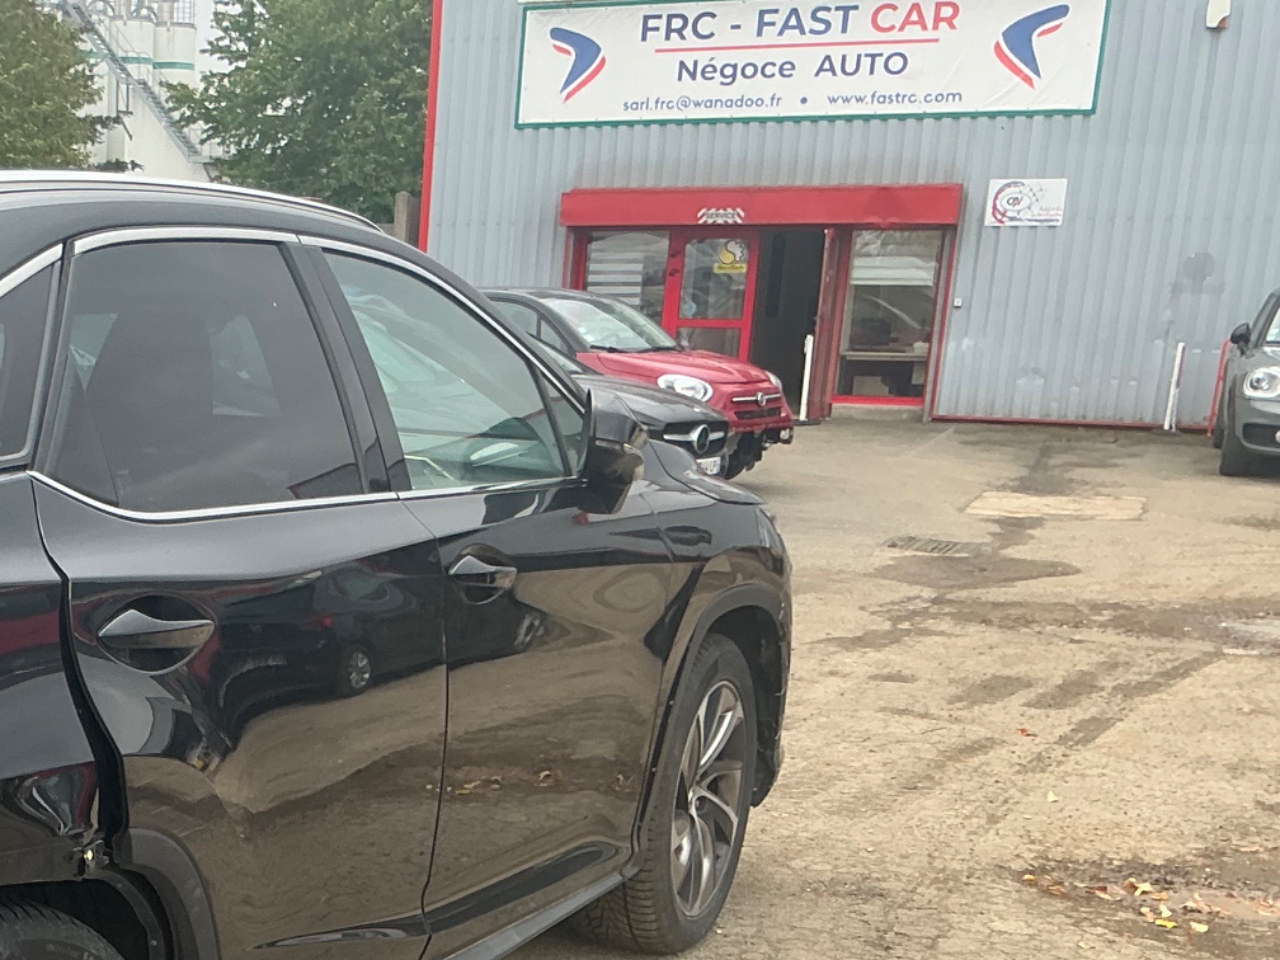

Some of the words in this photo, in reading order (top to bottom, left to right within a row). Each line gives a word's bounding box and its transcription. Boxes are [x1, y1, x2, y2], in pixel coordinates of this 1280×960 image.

[640, 11, 717, 42] FRC
[756, 4, 859, 37] FAST
[871, 1, 960, 33] CAR
[677, 56, 796, 86] Négoce
[814, 51, 908, 77] AUTO
[623, 93, 782, 112] sarl.frc@wanadoo.fr
[827, 90, 962, 106] www.fastrc.com
[705, 211, 736, 220] SERVICE
